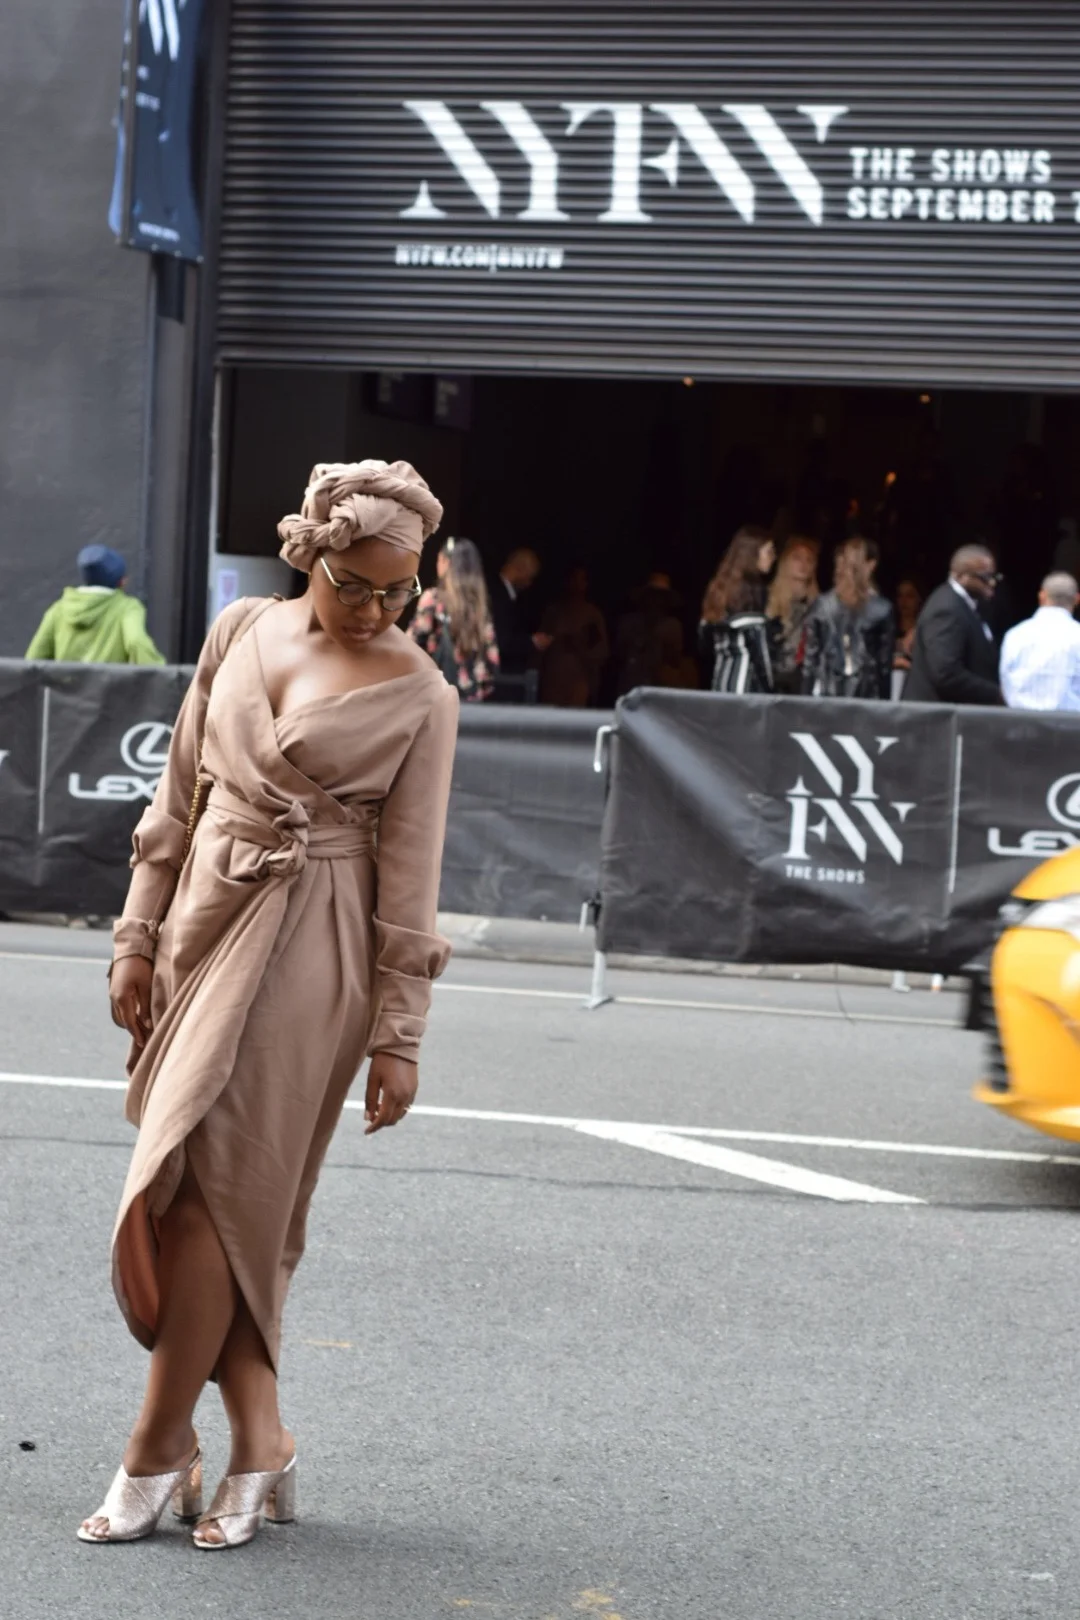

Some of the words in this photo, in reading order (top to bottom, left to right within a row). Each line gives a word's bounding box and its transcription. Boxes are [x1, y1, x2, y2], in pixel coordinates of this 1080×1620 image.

[399, 100, 849, 226] NYFW
[850, 147, 916, 181] THE
[931, 149, 1052, 183] SHOWS
[847, 186, 1056, 222] SEPTEMBER
[785, 732, 899, 799] NY
[68, 772, 160, 801] LEX
[782, 796, 917, 865] FW
[786, 864, 812, 880] THE
[816, 867, 865, 884] SHOWS
